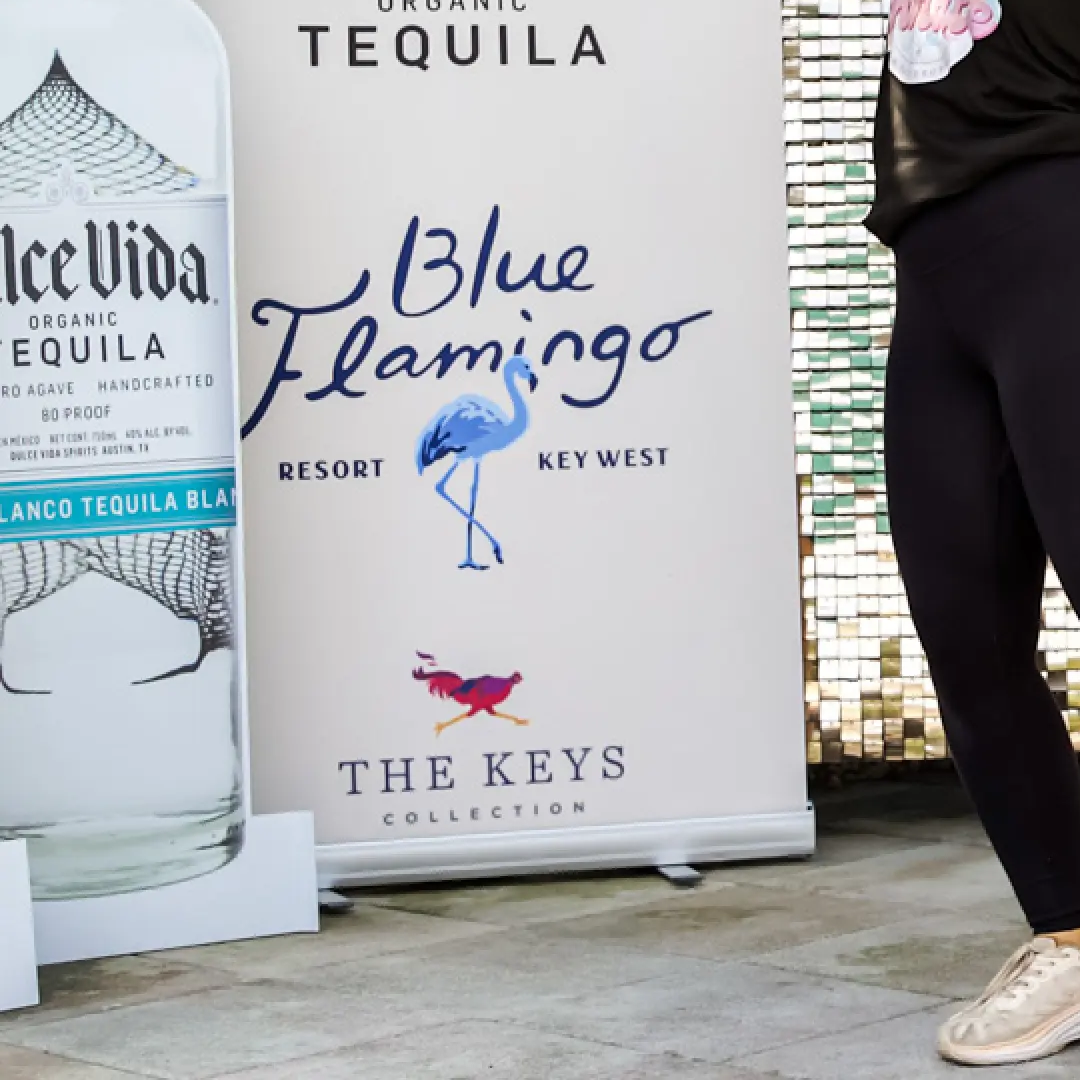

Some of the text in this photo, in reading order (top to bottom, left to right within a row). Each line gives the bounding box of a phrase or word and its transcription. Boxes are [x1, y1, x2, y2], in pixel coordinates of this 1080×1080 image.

[298, 23, 607, 72] TEQUILA
[0, 219, 211, 306] lce Vida
[392, 203, 595, 318] Blue
[29, 311, 119, 331] ORGANIC
[0, 332, 165, 368] EQUILA
[240, 268, 713, 441] Flamingo
[27, 381, 75, 397] AGAVE
[97, 373, 214, 393] HANDCRAFTED
[63, 404, 111, 420] PROOF
[278, 447, 670, 481] RESORT KEY WEST
[82, 492, 178, 518] TEQUILA
[338, 745, 625, 796] THE KEYS
[383, 801, 586, 826] COLLECTION
